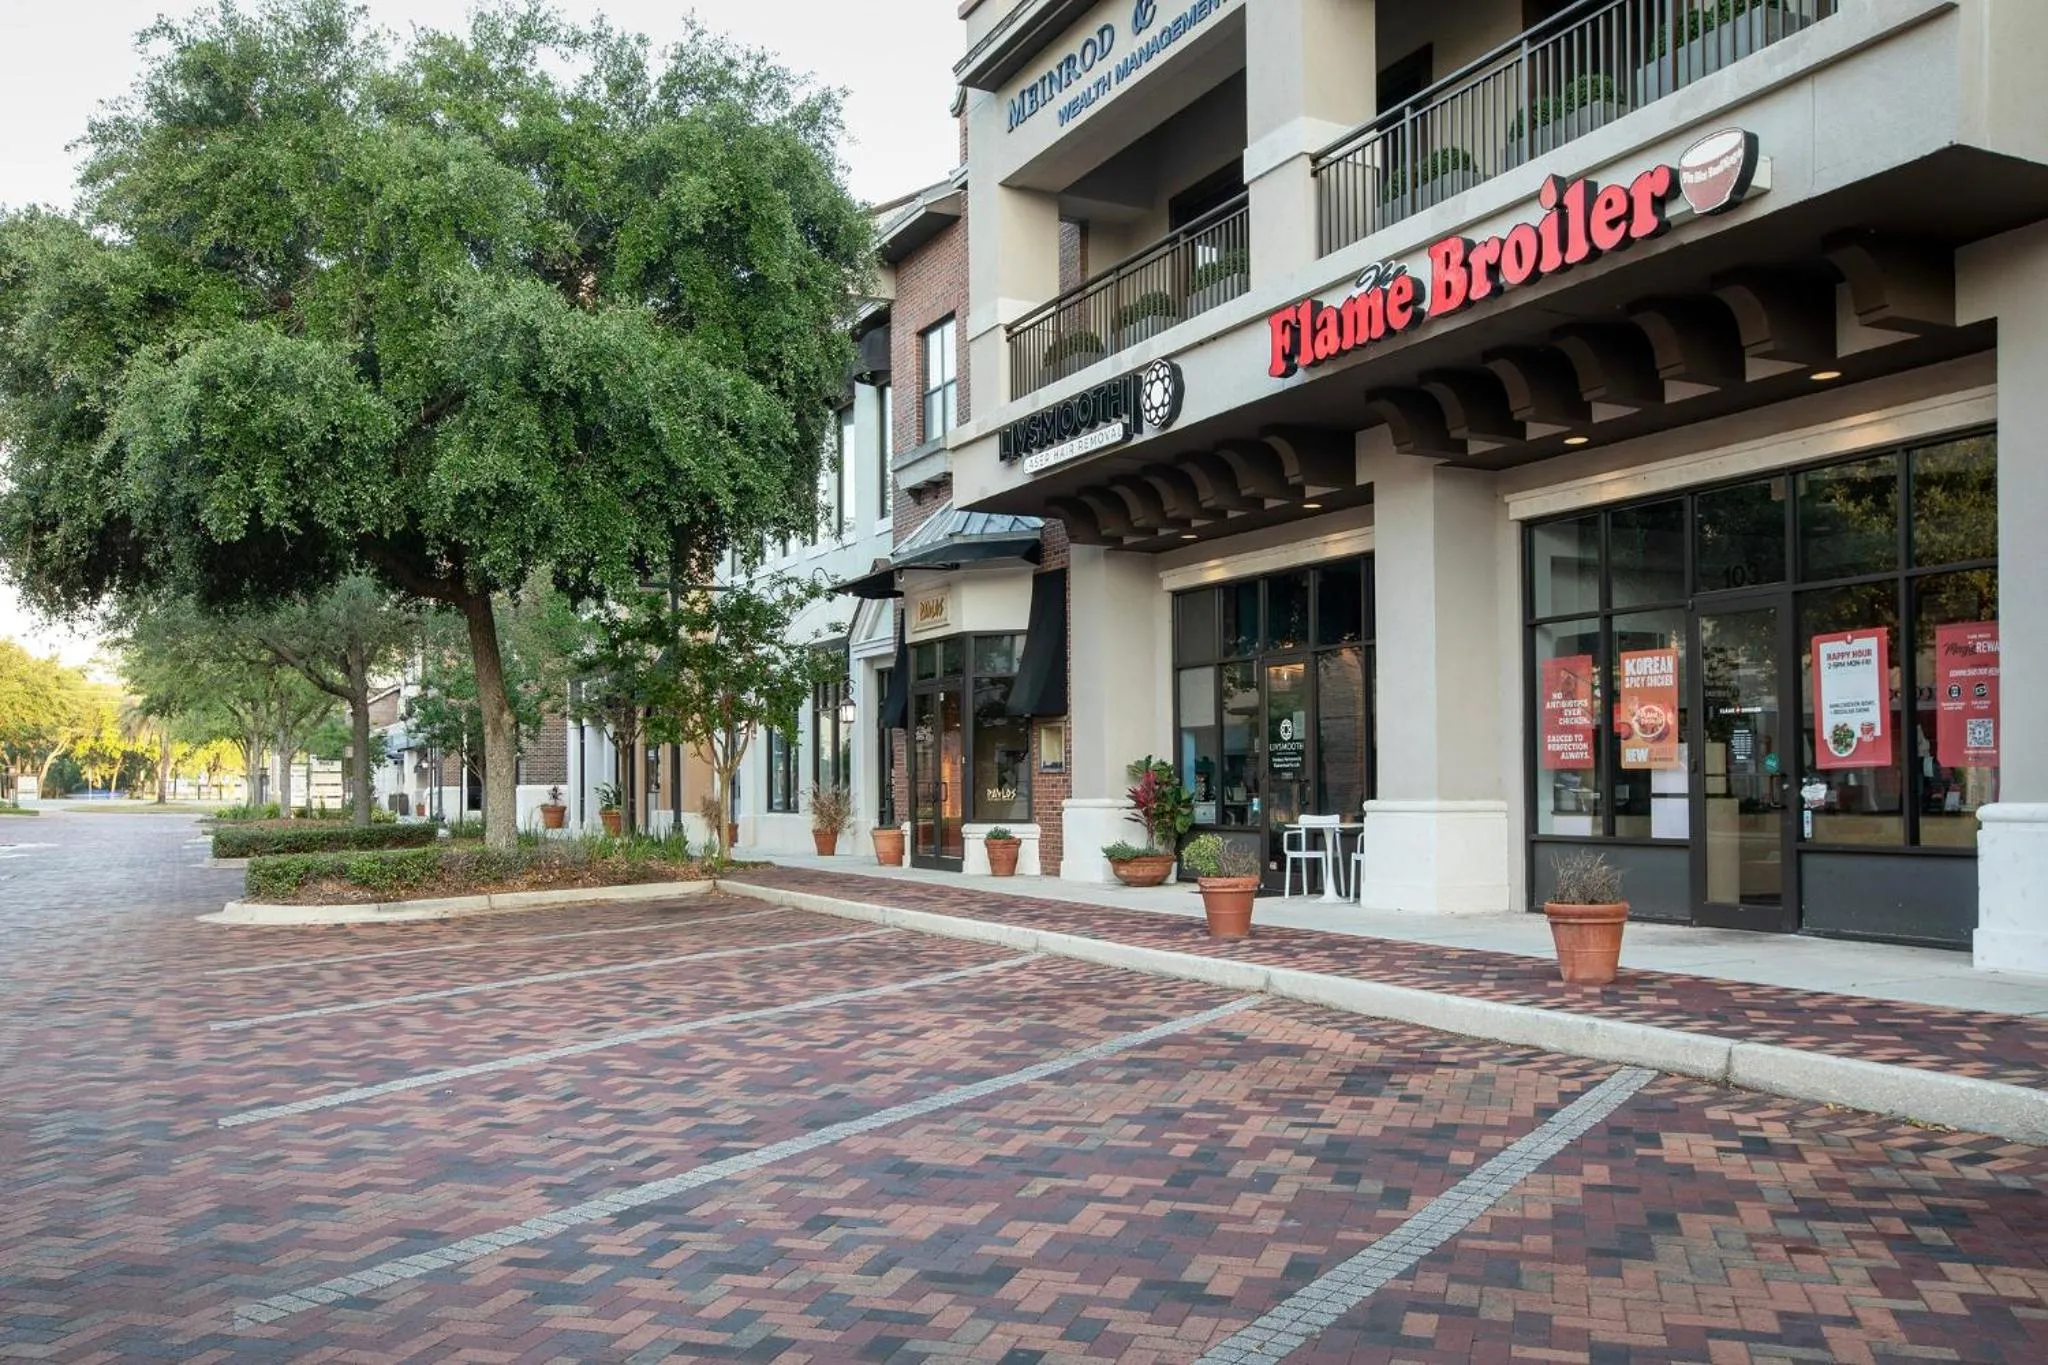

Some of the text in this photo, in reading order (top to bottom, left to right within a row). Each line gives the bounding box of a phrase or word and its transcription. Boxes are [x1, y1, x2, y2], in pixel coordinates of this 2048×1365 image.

[1058, 0, 1227, 127] WEALTH MANAGEMEN
[1007, 23, 1114, 133] MEINROD
[1267, 164, 1676, 379] Flame Broiler
[1827, 648, 1872, 661] HAPPY HOUR
[1625, 656, 1673, 676] KOREAN
[1625, 674, 1673, 689] SPICY CHICKEN
[1547, 734, 1583, 742] SAUCED TO
[1548, 742, 1588, 751] PERFECTION
[1625, 748, 1649, 762] NEW
